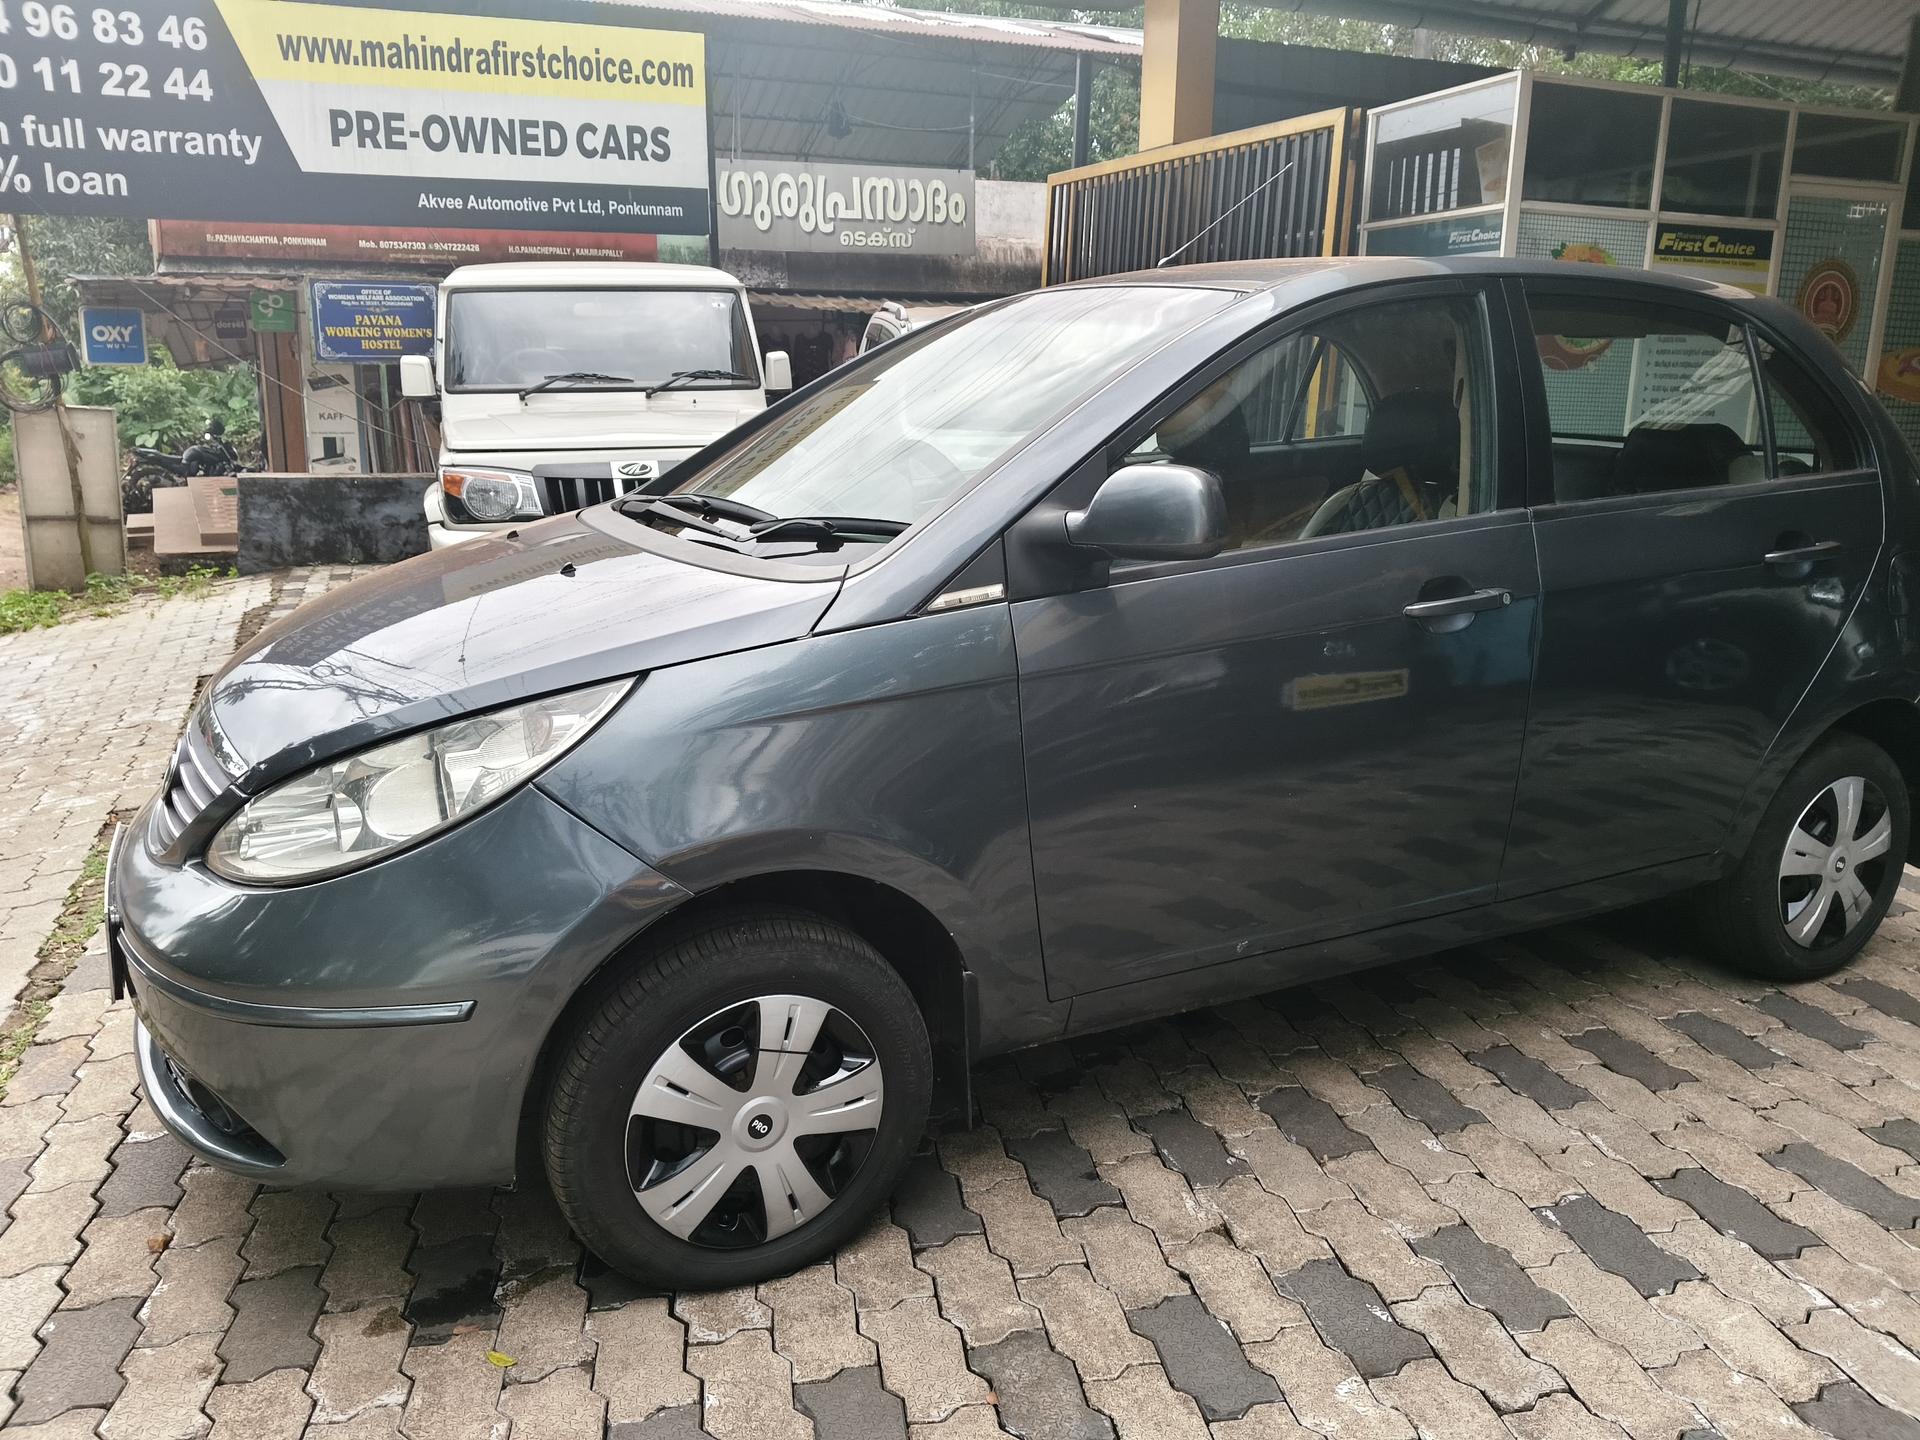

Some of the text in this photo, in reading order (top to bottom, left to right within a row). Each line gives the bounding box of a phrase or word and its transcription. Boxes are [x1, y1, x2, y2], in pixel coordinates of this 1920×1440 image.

[21, 1, 78, 40] 96
[92, 8, 144, 46] 83
[157, 15, 208, 51] 46
[277, 33, 694, 88] www.mahindrafirstchoice.com
[33, 56, 82, 94] 11
[98, 62, 151, 98] 22
[163, 67, 213, 102] 44
[20, 114, 85, 149] full
[96, 127, 262, 165] warranty
[329, 109, 671, 163] PRE-OWNED CARS
[44, 162, 128, 196] loan
[418, 193, 683, 217] Akvee Automotive Pvt Ltd, Ponkunnam
[719, 170, 967, 233] ഗുരുപ്രസാദം
[359, 240, 378, 248] Mob.
[1659, 233, 1755, 255] First Choice
[325, 327, 433, 338] WORKING WOMEN'S
[355, 315, 402, 326] PAVANA
[92, 325, 133, 342] OXY
[362, 340, 403, 350] HOSTEL
[752, 1119, 768, 1133] PRO
